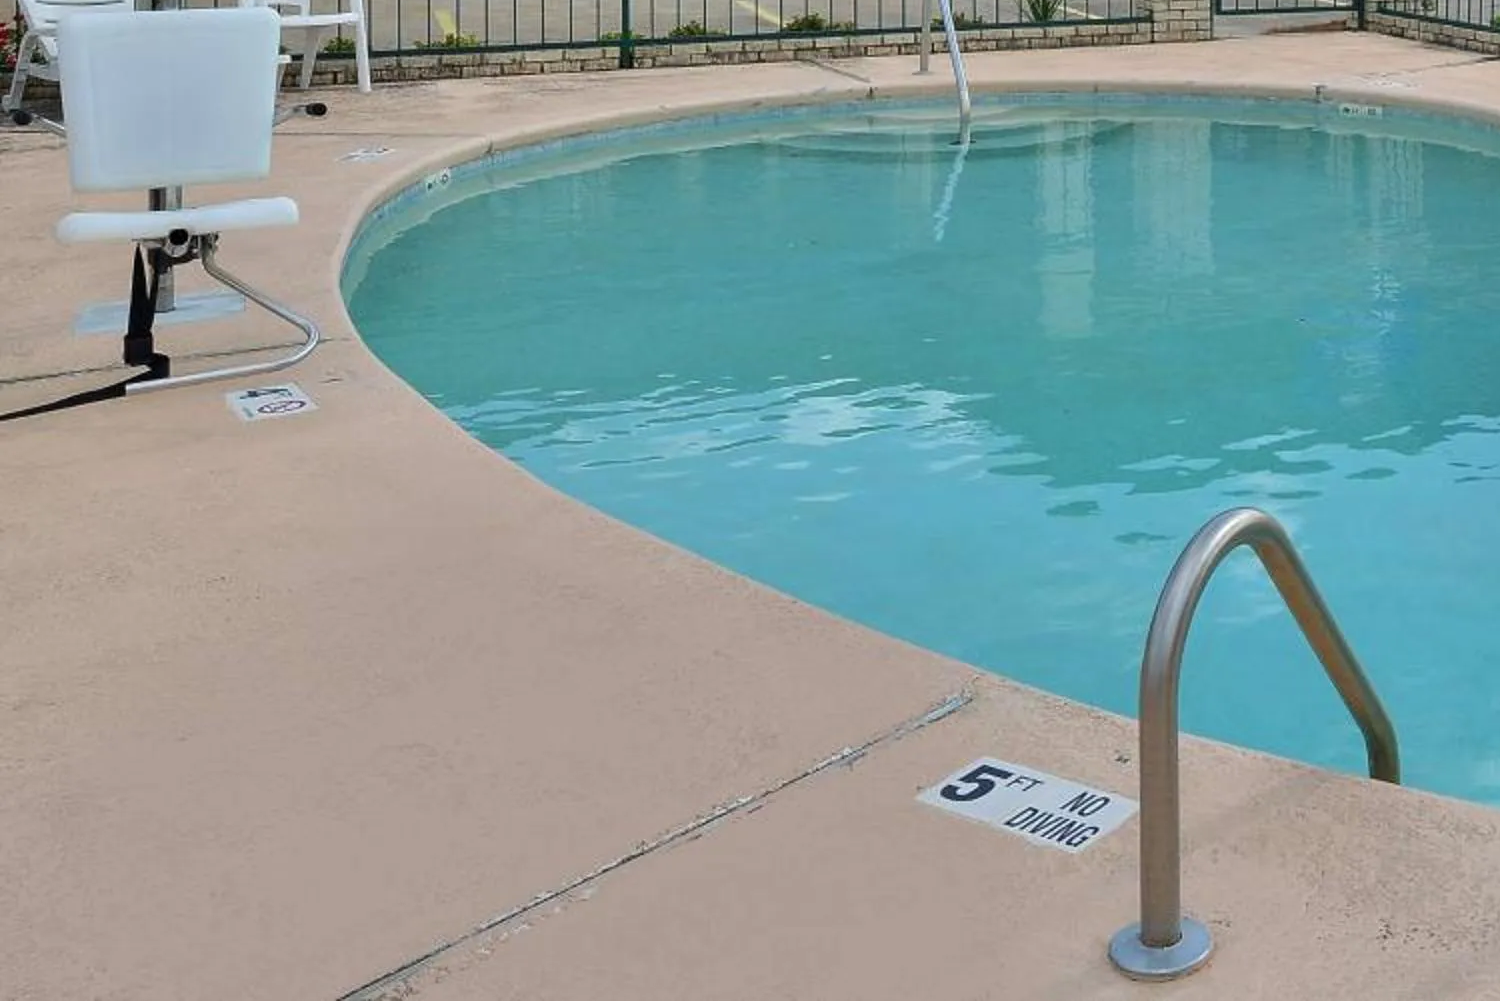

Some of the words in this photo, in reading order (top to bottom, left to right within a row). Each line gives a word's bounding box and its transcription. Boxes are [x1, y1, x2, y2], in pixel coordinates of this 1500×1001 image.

[940, 764, 1012, 802] 5
[1005, 776, 1045, 792] FT
[1060, 791, 1110, 817] NO
[1004, 807, 1099, 847] DIVING
